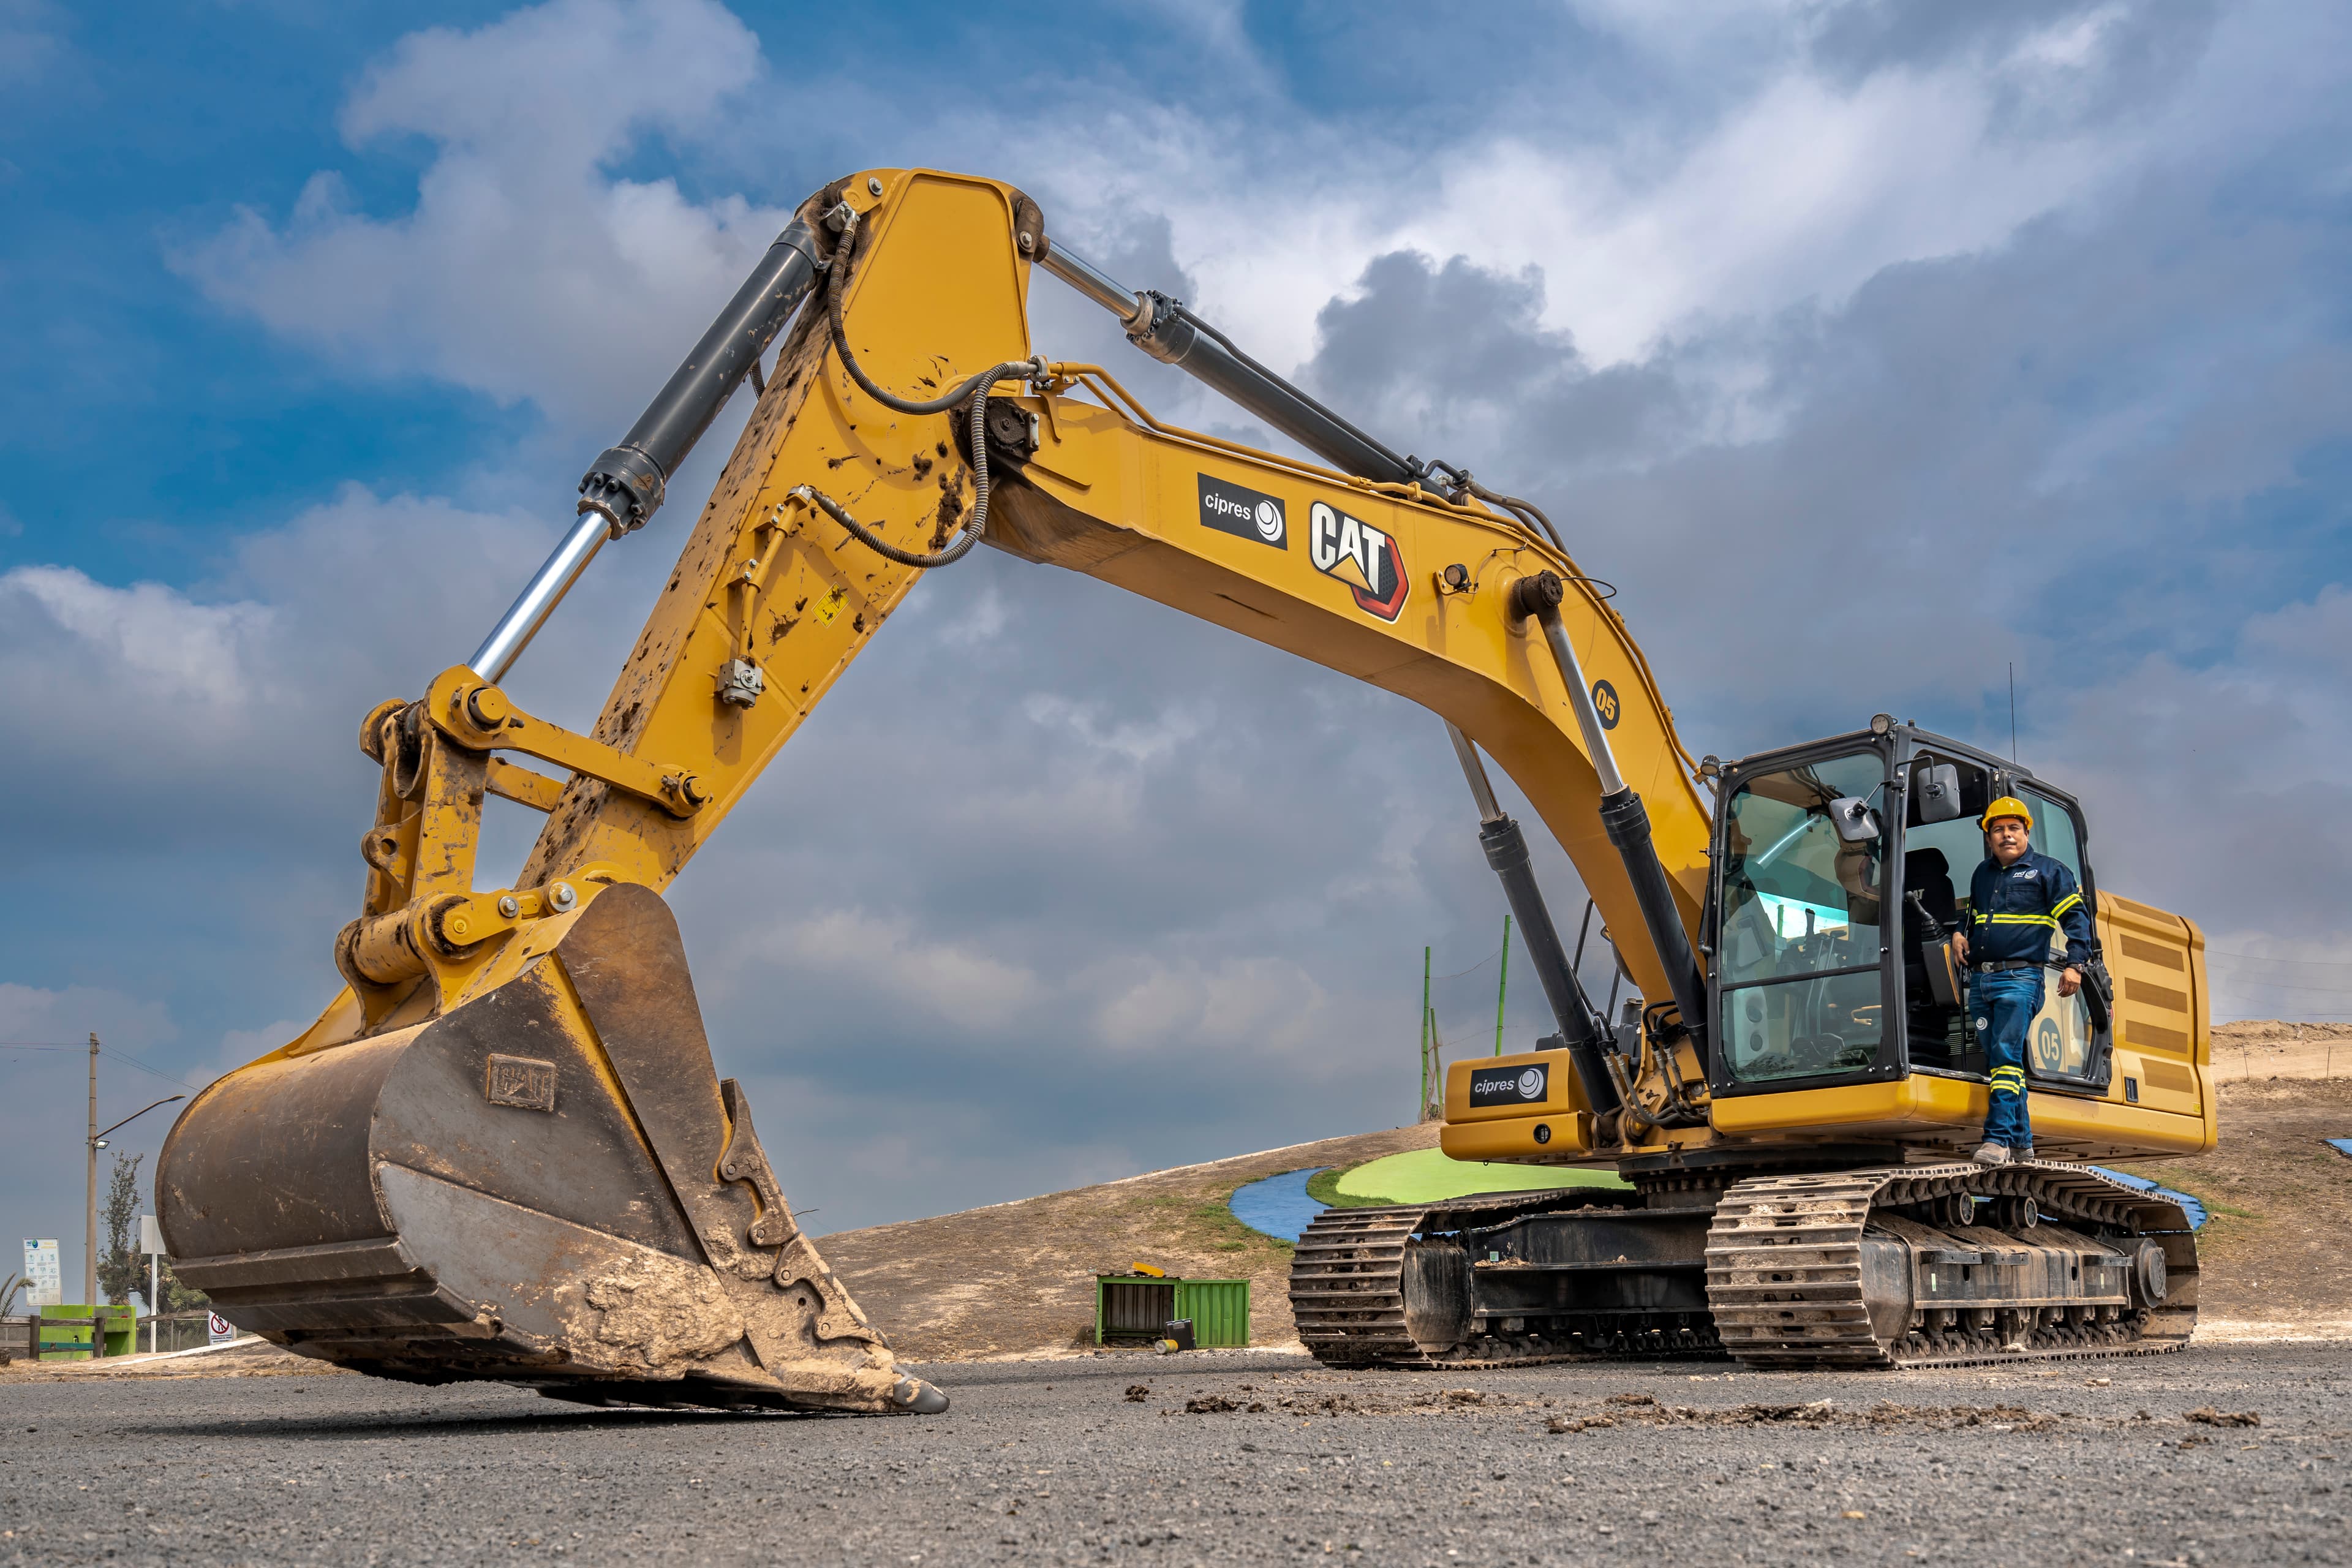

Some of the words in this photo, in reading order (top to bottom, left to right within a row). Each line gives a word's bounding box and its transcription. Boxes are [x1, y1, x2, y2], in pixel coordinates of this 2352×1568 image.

[1205, 492, 1251, 521] cipres
[1311, 502, 1385, 595] CAT
[1596, 687, 1616, 720] 05
[1913, 888, 1925, 900] AT
[2041, 1030, 2059, 1061] 05
[1474, 1079, 1515, 1095] cipres
